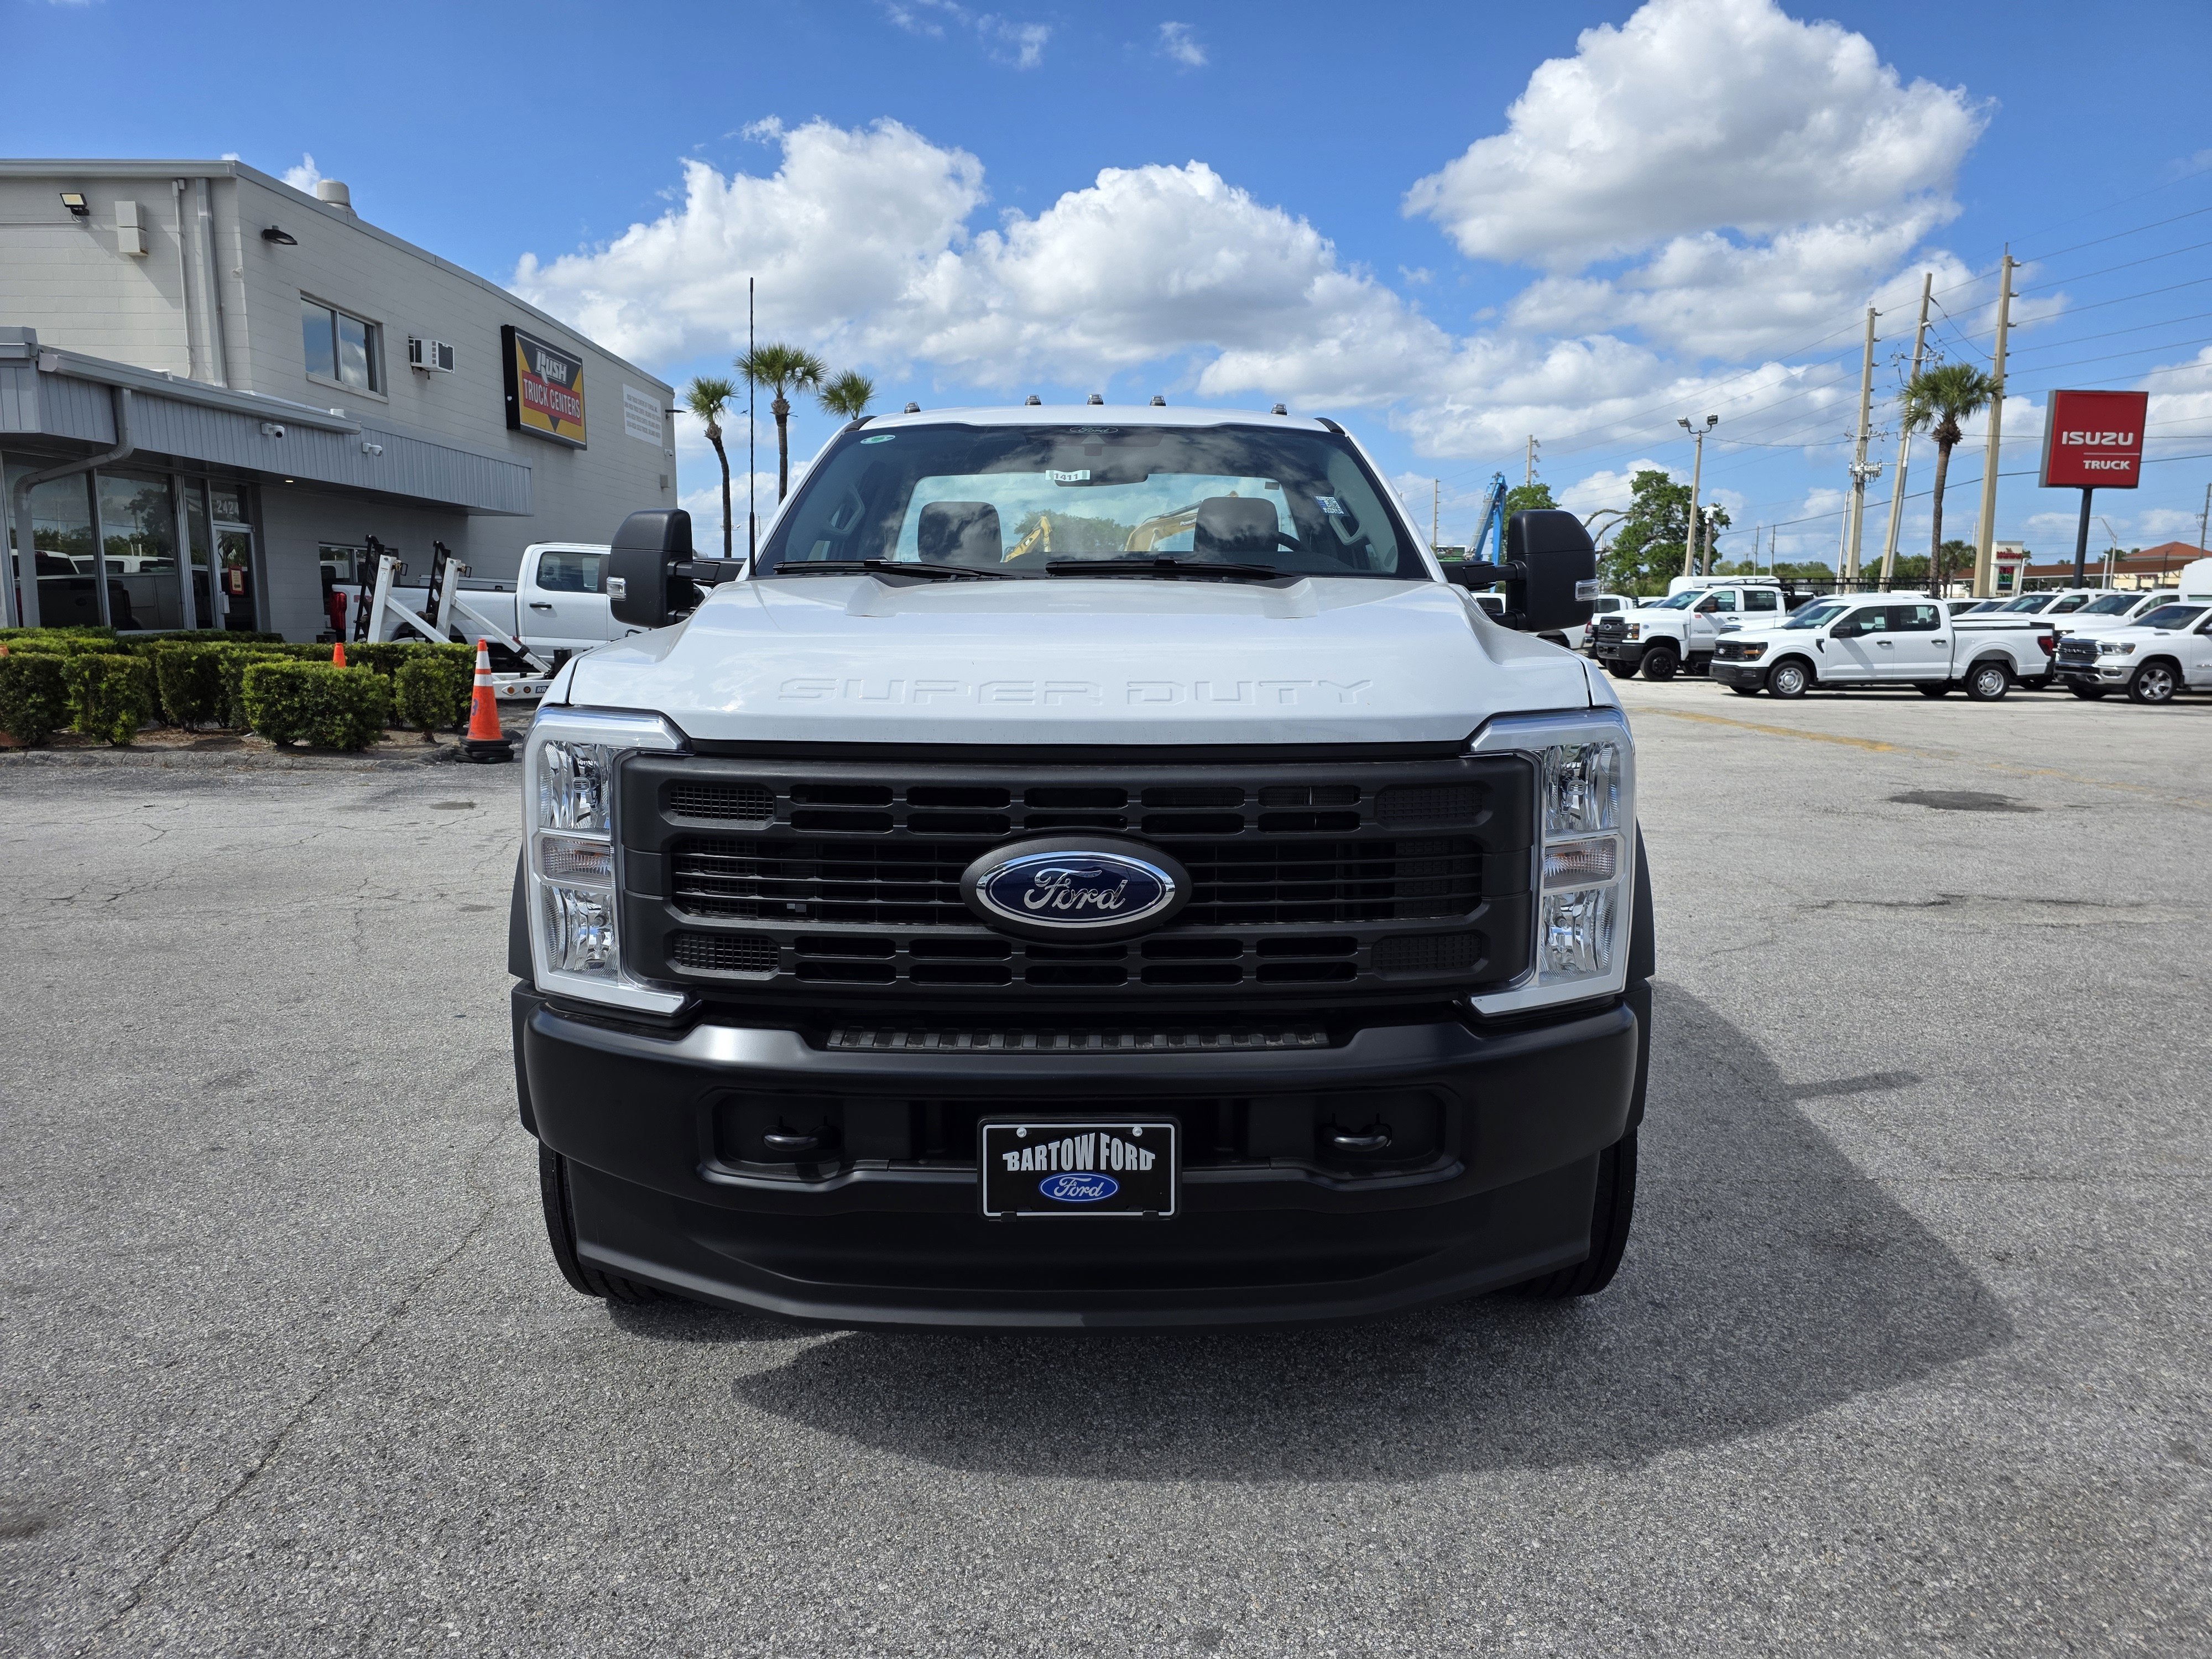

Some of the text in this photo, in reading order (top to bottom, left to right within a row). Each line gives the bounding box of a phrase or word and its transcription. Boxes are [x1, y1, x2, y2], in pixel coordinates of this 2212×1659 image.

[535, 348, 567, 386] RUSH
[523, 378, 580, 419] TRUCK CENTERS
[2062, 431, 2134, 446] ISUZU
[2083, 460, 2131, 470] TRUCK
[216, 499, 239, 515] 2424
[778, 678, 1374, 705] SUPER DUTY
[1024, 867, 1128, 910] Ford
[1002, 1132, 1156, 1171] BARTOW FORD
[1053, 1176, 1104, 1197] Ford
